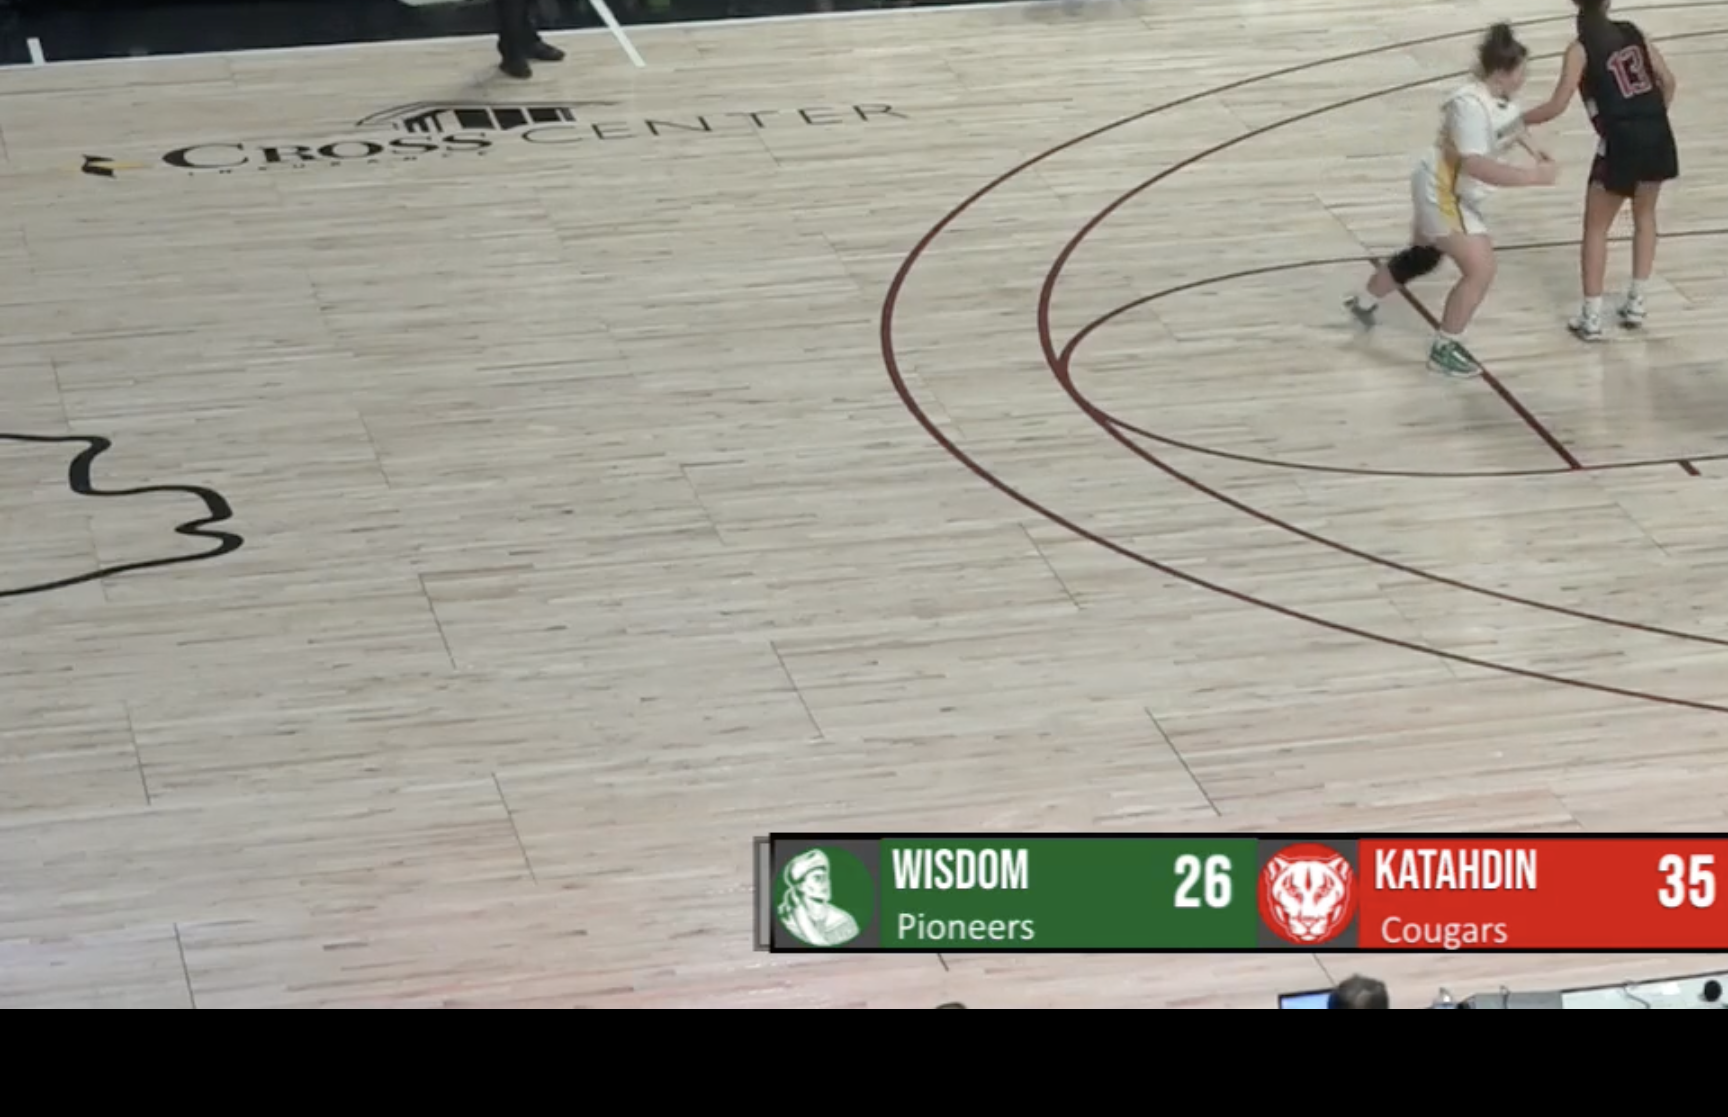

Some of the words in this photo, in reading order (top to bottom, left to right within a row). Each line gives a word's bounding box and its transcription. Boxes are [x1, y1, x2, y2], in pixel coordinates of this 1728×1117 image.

[1606, 44, 1652, 98] 13
[161, 131, 493, 170] CROSS
[521, 102, 909, 144] CENTER
